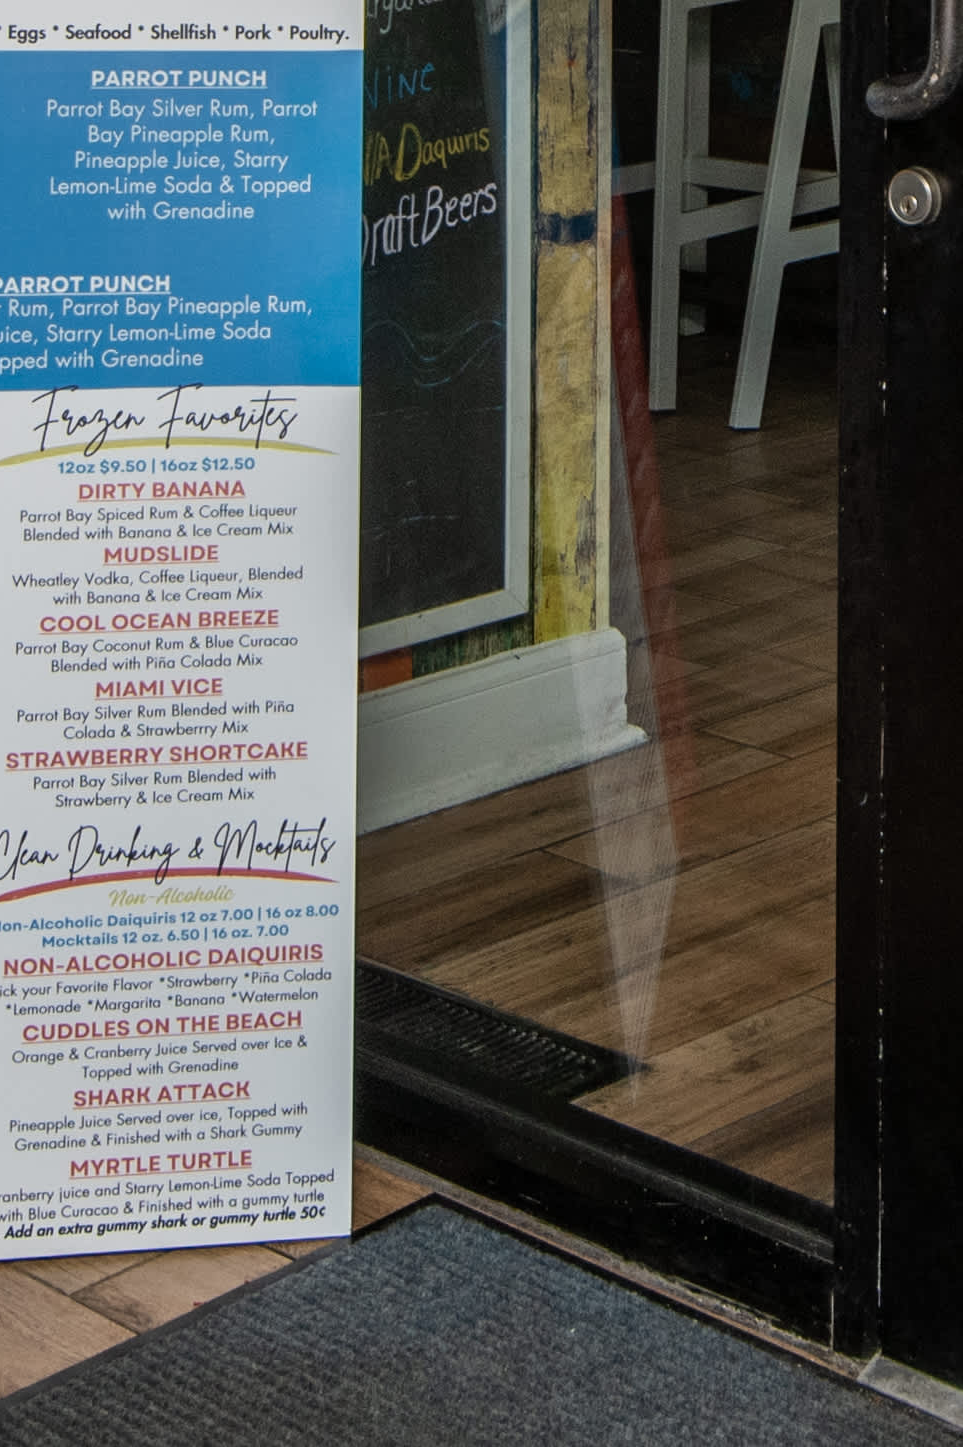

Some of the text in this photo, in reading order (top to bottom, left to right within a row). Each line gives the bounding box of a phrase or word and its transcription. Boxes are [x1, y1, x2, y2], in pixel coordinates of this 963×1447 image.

[108, 203, 254, 221] with Grenadine
[422, 185, 497, 245] Beers
[32, 382, 299, 457] Frozen Favorites
[104, 545, 219, 563] MUDSLIDE
[73, 1081, 250, 1106] SHARK ATTACK
[69, 1150, 252, 1176] MYRTLE TURTLE
